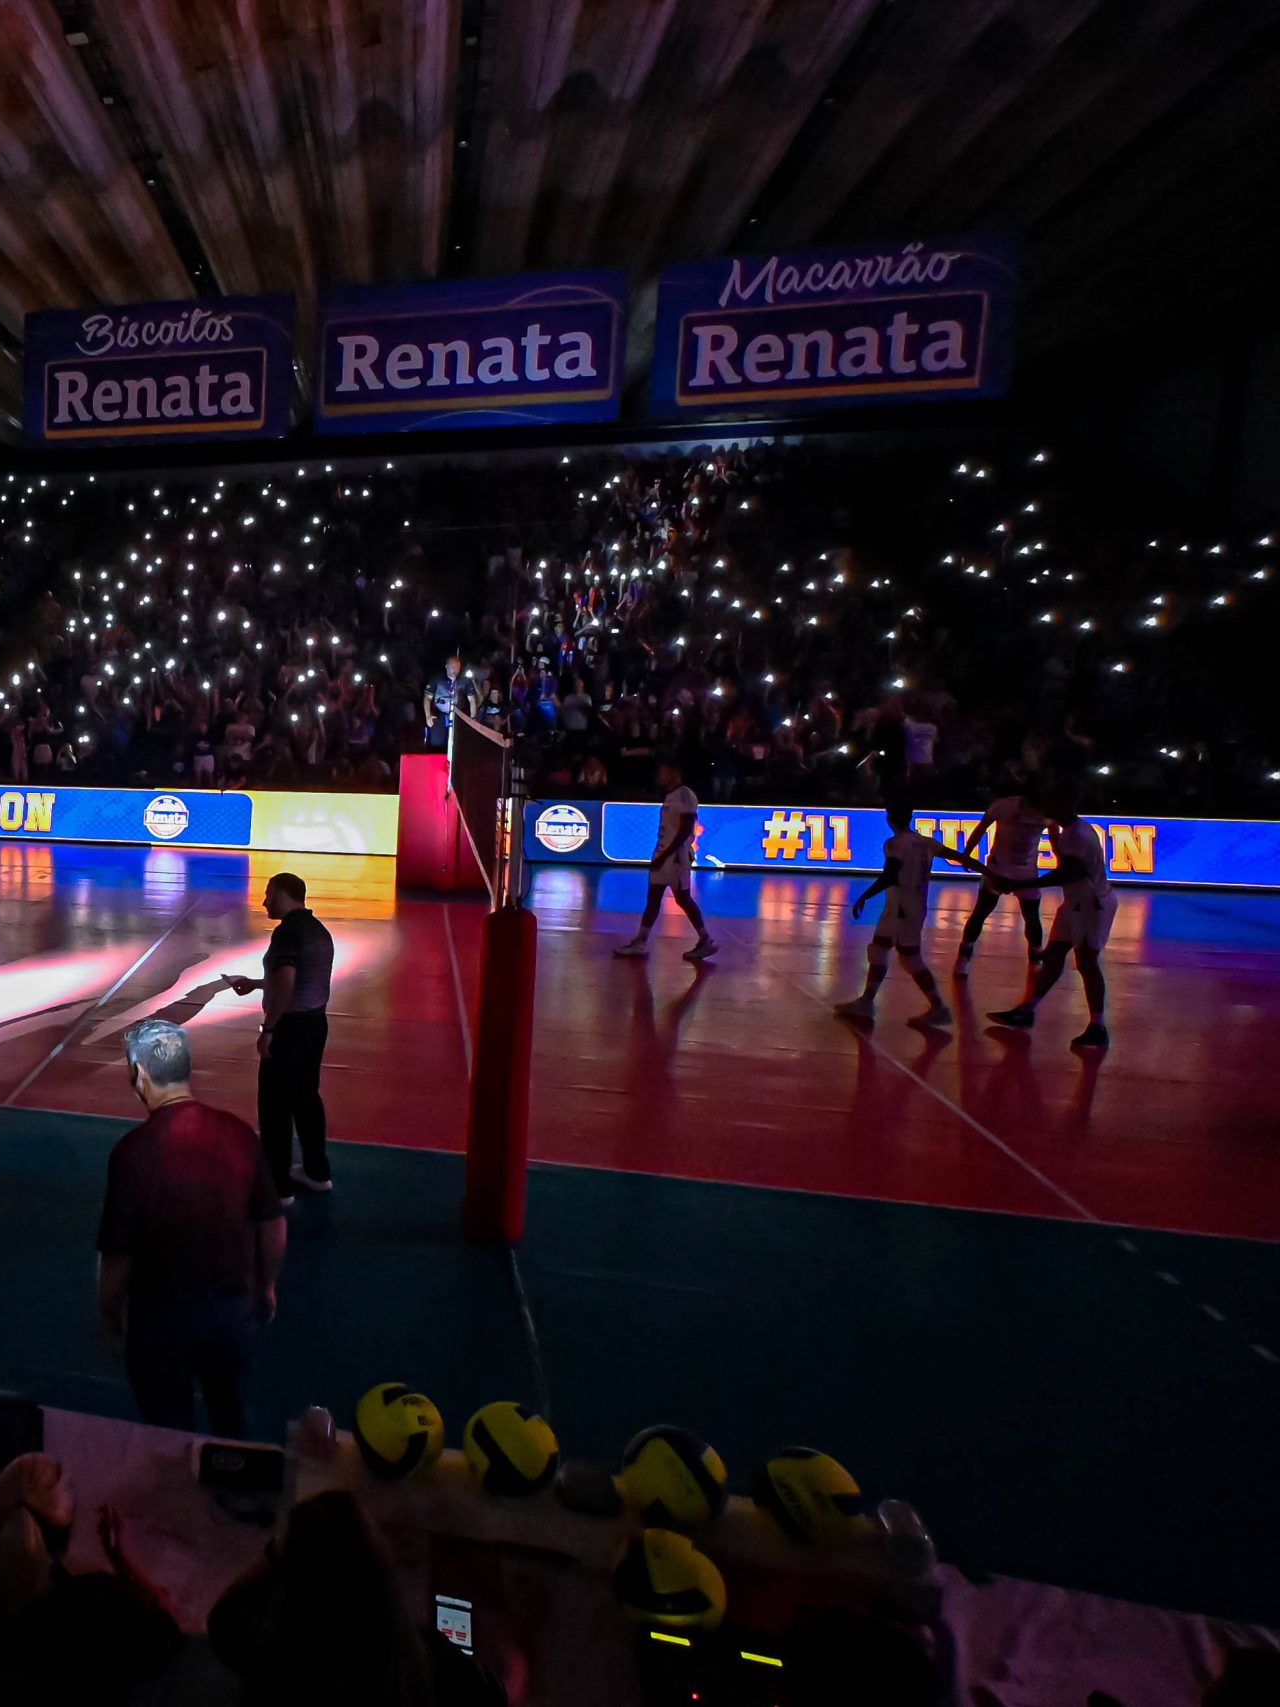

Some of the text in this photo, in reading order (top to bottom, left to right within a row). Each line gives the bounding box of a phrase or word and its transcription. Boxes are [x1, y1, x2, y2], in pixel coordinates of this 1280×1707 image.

[718, 240, 960, 307] Macarrão
[75, 312, 234, 356] Biscoitos
[335, 322, 597, 393] Renata
[688, 311, 967, 388] Renata
[52, 364, 255, 424] Renata
[538, 821, 587, 837] Renata
[761, 810, 853, 861] #11
